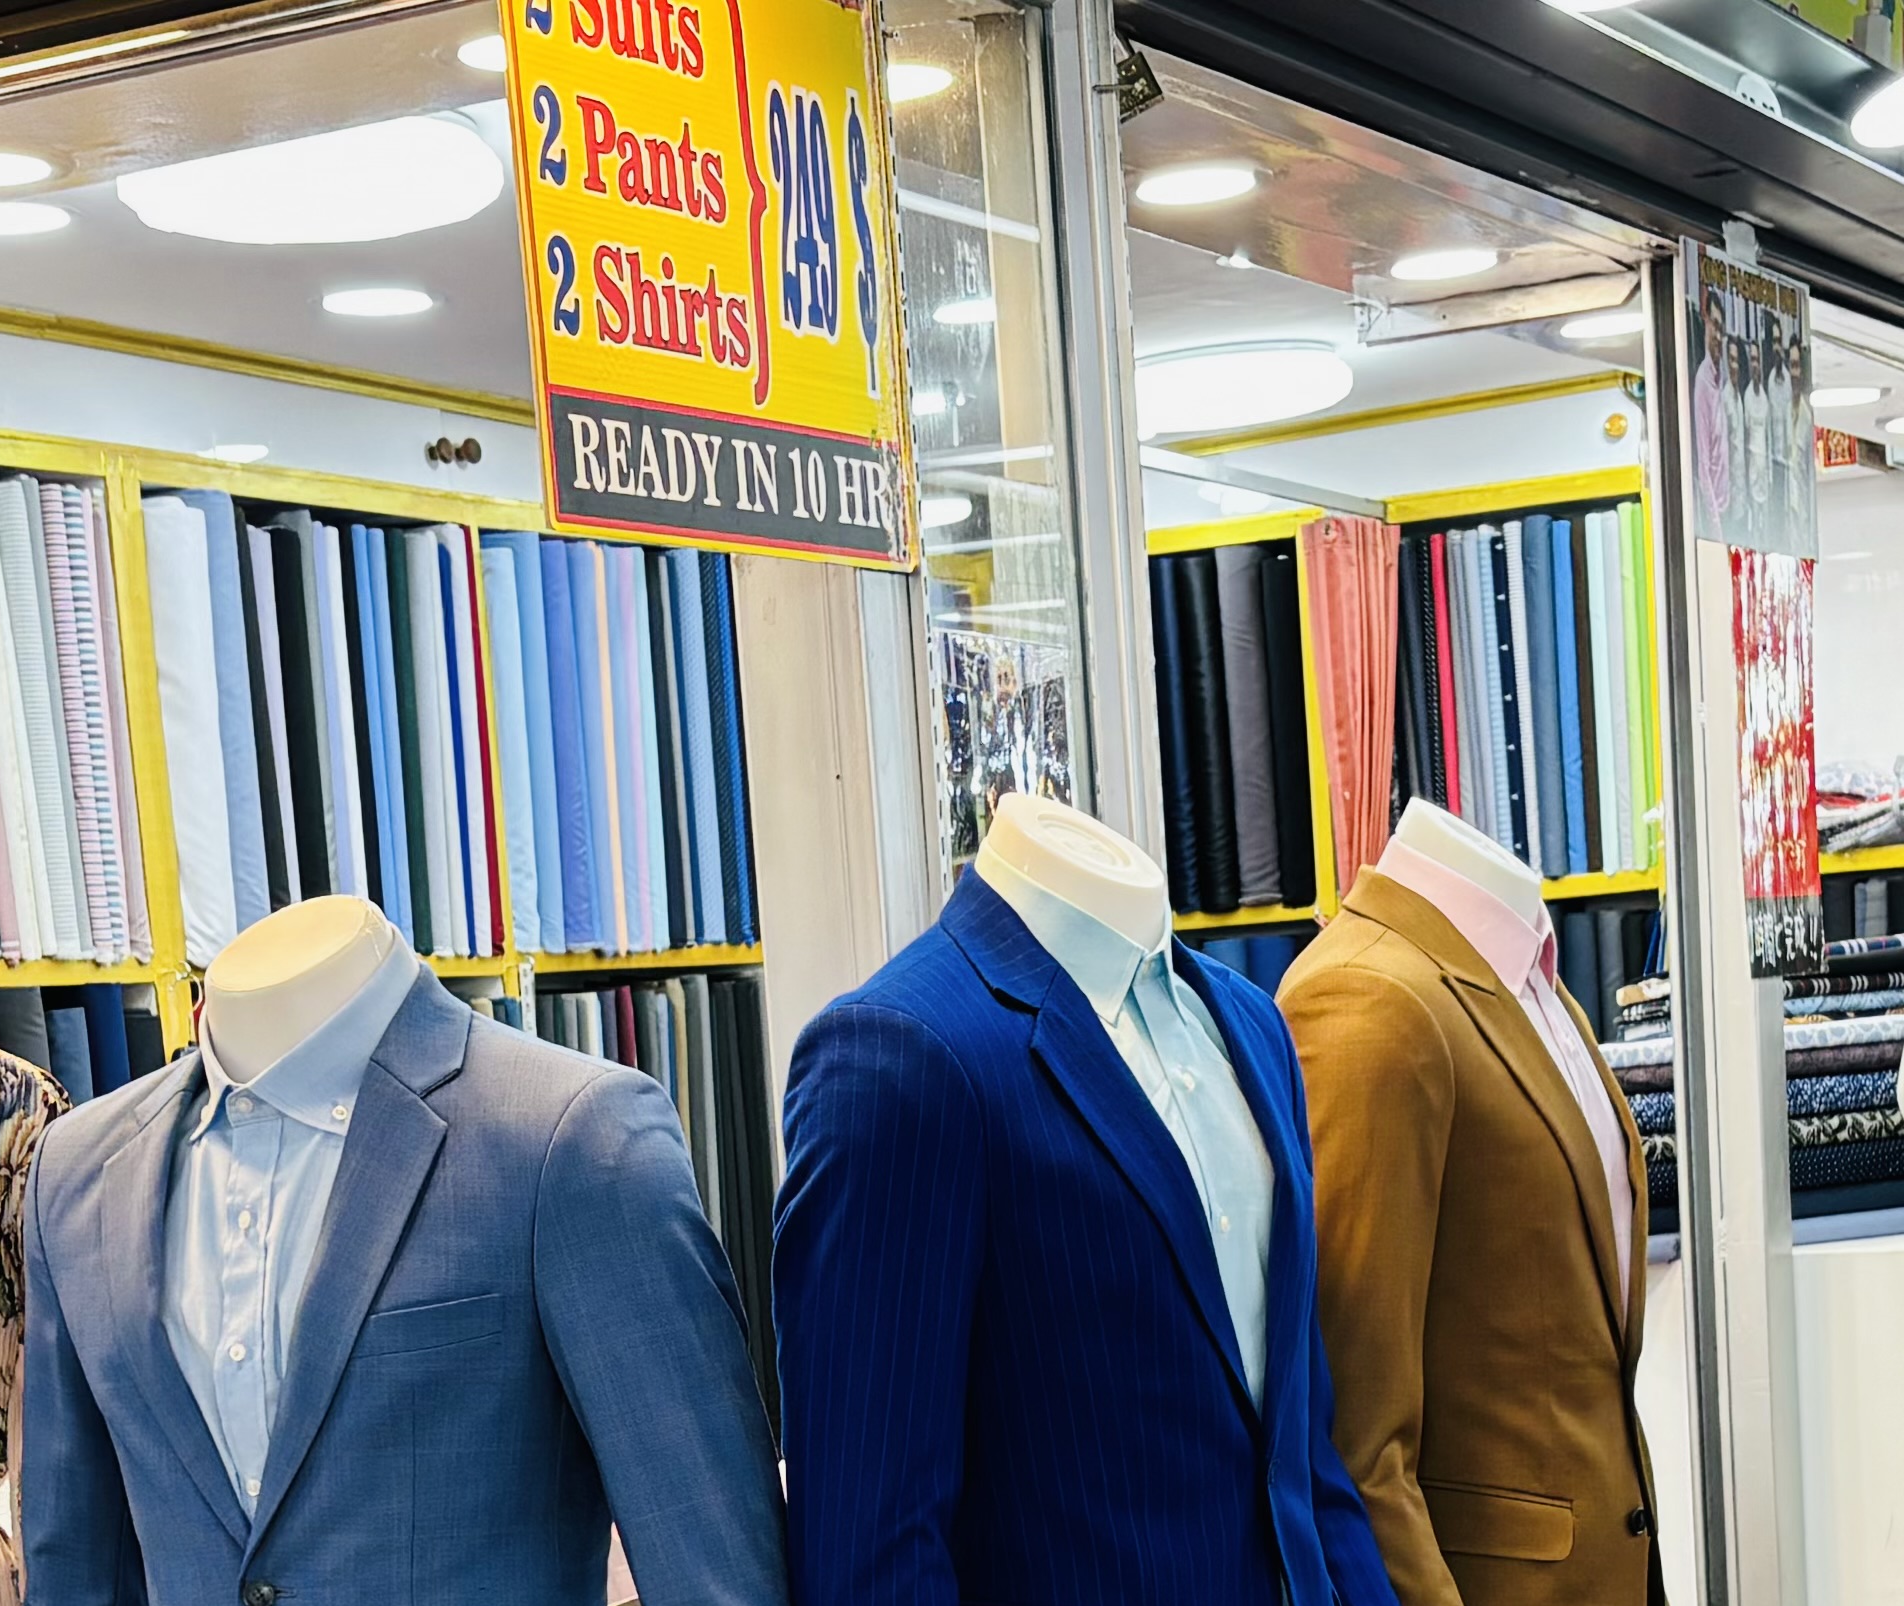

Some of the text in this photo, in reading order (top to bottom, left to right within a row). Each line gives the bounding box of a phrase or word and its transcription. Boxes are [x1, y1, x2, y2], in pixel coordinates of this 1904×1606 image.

[534, 85, 727, 223] 2 Pants
[768, 88, 837, 338] 249
[547, 235, 753, 369] 2 Shirts
[568, 412, 721, 513] READY
[732, 438, 780, 516] IN
[789, 447, 828, 522] 10
